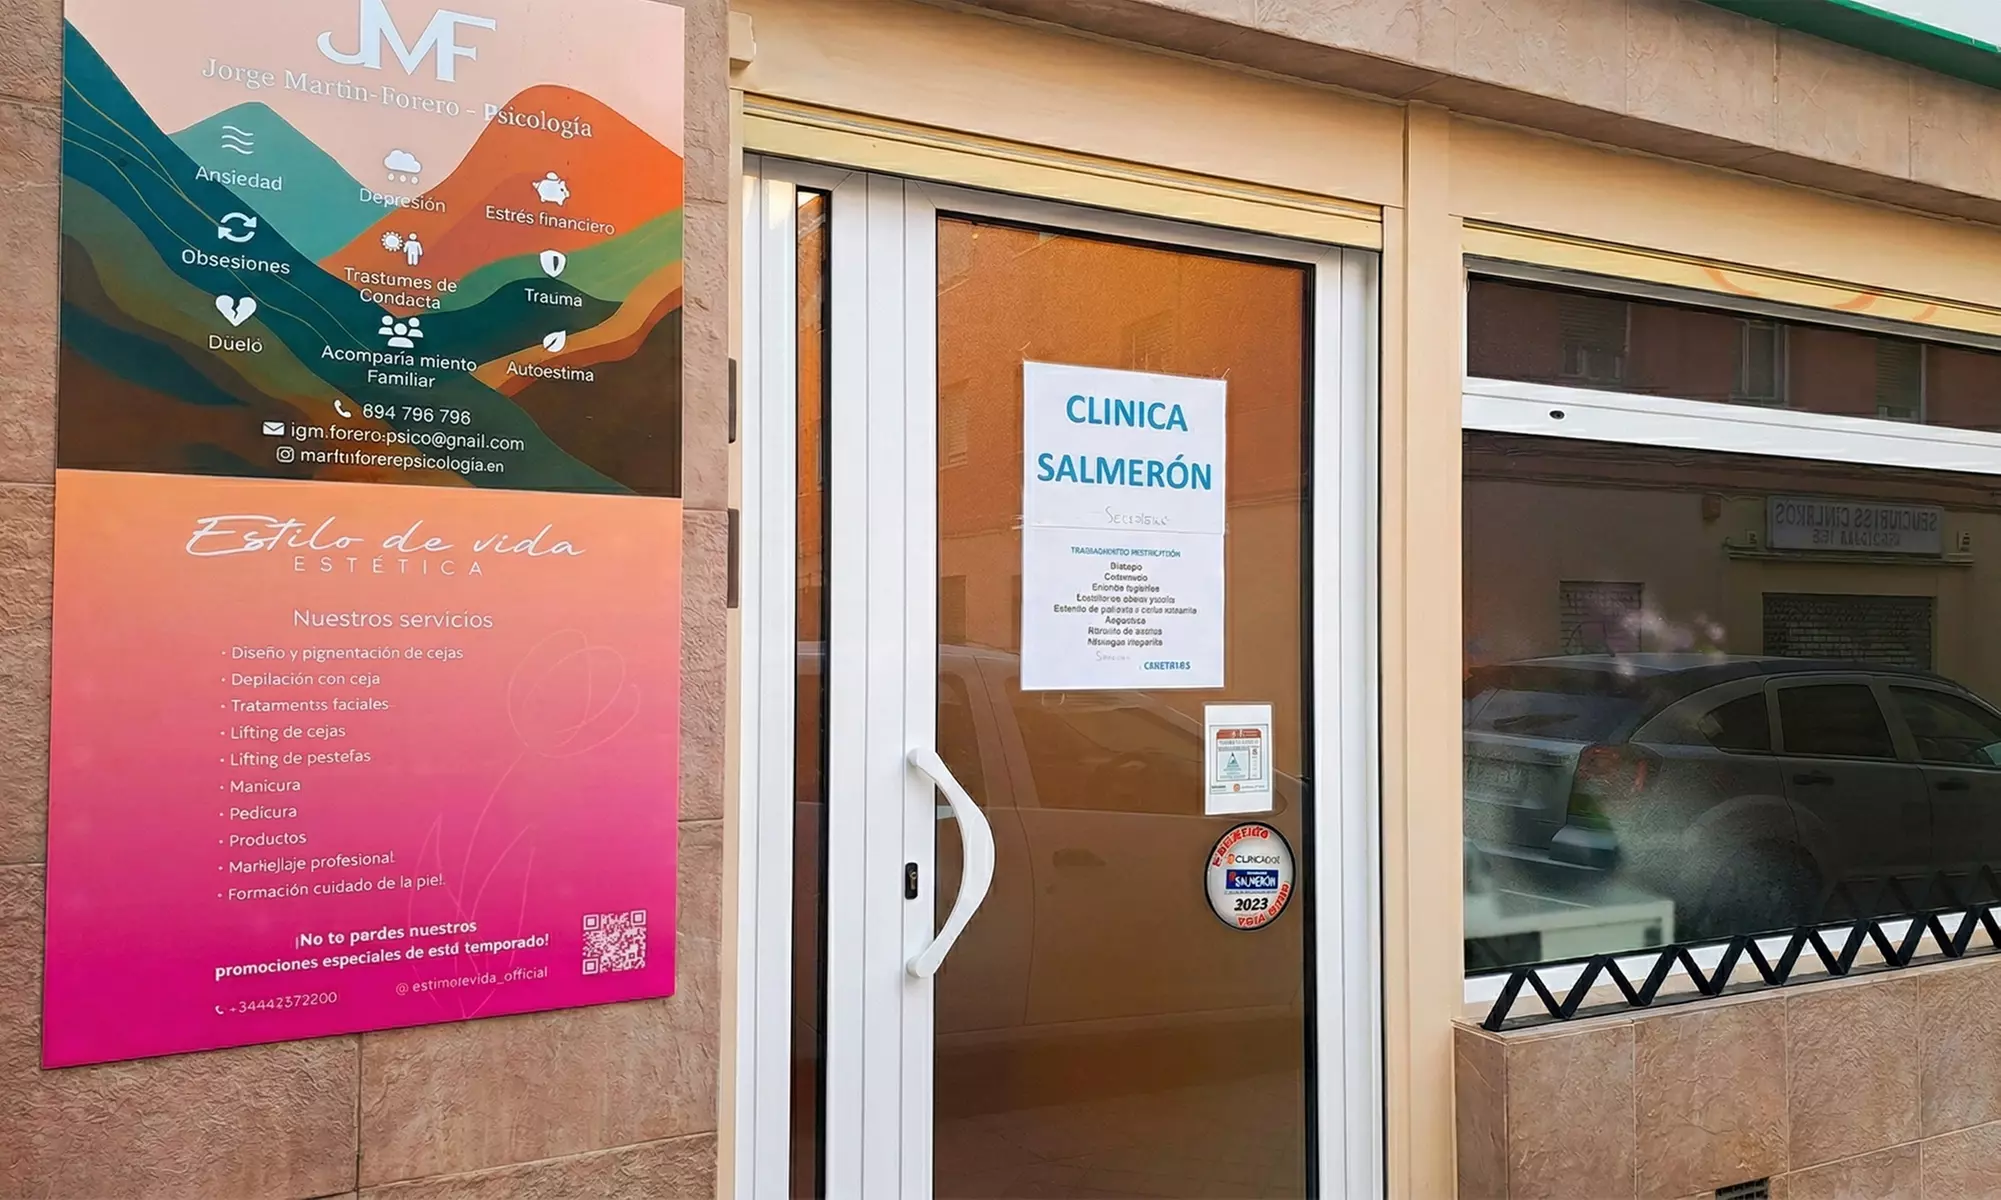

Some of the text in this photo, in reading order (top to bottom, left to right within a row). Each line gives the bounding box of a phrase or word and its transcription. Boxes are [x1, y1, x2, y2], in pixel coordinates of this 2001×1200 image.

[317, 0, 496, 82] JMF
[202, 57, 275, 89] Jorge
[484, 102, 593, 140] Psicología
[195, 166, 283, 191] Ansiedad
[359, 187, 446, 213] Depresión
[486, 204, 616, 236] Estrés financiero
[181, 249, 291, 275] Obsesiones
[344, 266, 458, 293] Trastumes de
[359, 289, 441, 310] Condacta
[420, 354, 478, 372] miento
[506, 360, 595, 382] Autoestima
[367, 369, 436, 389] Familiar
[401, 406, 434, 423] 796
[440, 408, 472, 426] 796
[1066, 394, 1189, 433] CLINICA
[1037, 452, 1212, 491] SALMERÓN
[185, 514, 587, 558] Estilo de vida
[294, 553, 483, 577] ESTÉTICA
[293, 609, 494, 630] Nuestros servicios
[231, 645, 286, 660] Diseño
[289, 649, 298, 662] y
[404, 646, 423, 660] de
[426, 646, 464, 662] cejas
[231, 672, 381, 688] Depilación con ceja
[332, 697, 389, 712] faciales
[230, 725, 346, 742] Lifting de cejas
[230, 752, 279, 768] Lifting
[283, 752, 303, 765] de
[230, 778, 301, 794] Manicura
[229, 832, 307, 848] Productos
[228, 882, 309, 901] Formación
[313, 877, 373, 896] cuidado
[376, 876, 396, 890] de
[400, 875, 412, 889] la
[1233, 897, 1269, 912] 2023
[409, 920, 477, 938] nuestros
[214, 957, 318, 982] promociones
[322, 947, 401, 970] especiales
[405, 945, 424, 960] de
